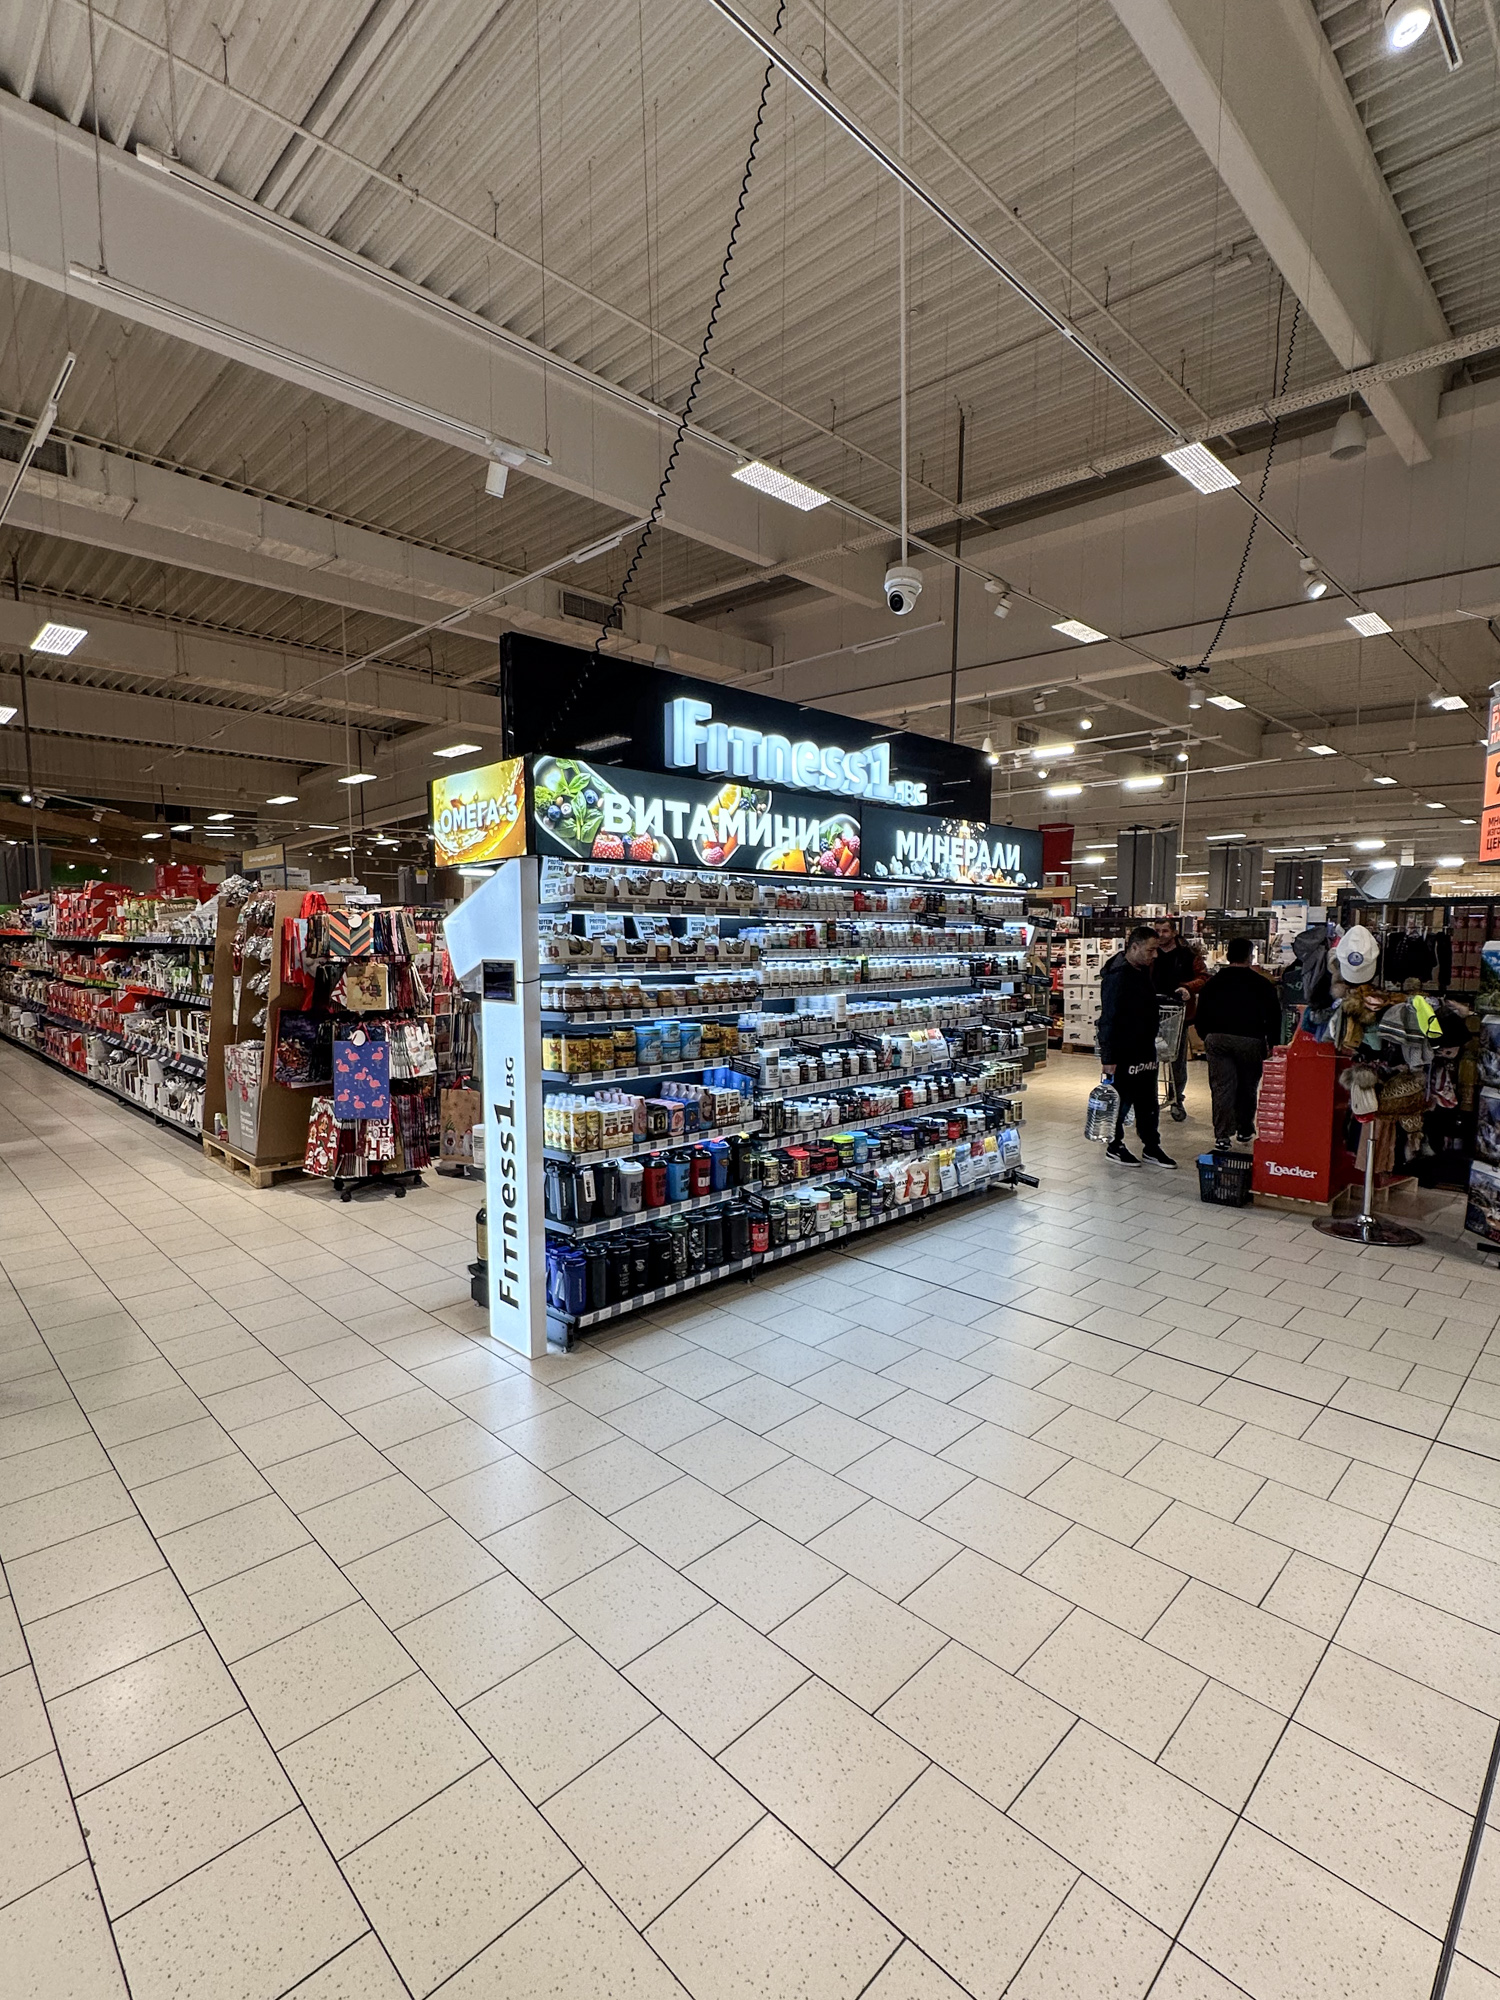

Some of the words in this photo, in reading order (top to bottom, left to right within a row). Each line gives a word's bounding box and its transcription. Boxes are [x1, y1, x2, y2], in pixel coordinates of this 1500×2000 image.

[440, 794, 519, 833] ОМЕГА-3
[601, 792, 821, 853] ВИТАМИНИ
[896, 829, 1021, 872] МИНЕРАЛИ
[1265, 1161, 1318, 1179] Loacker
